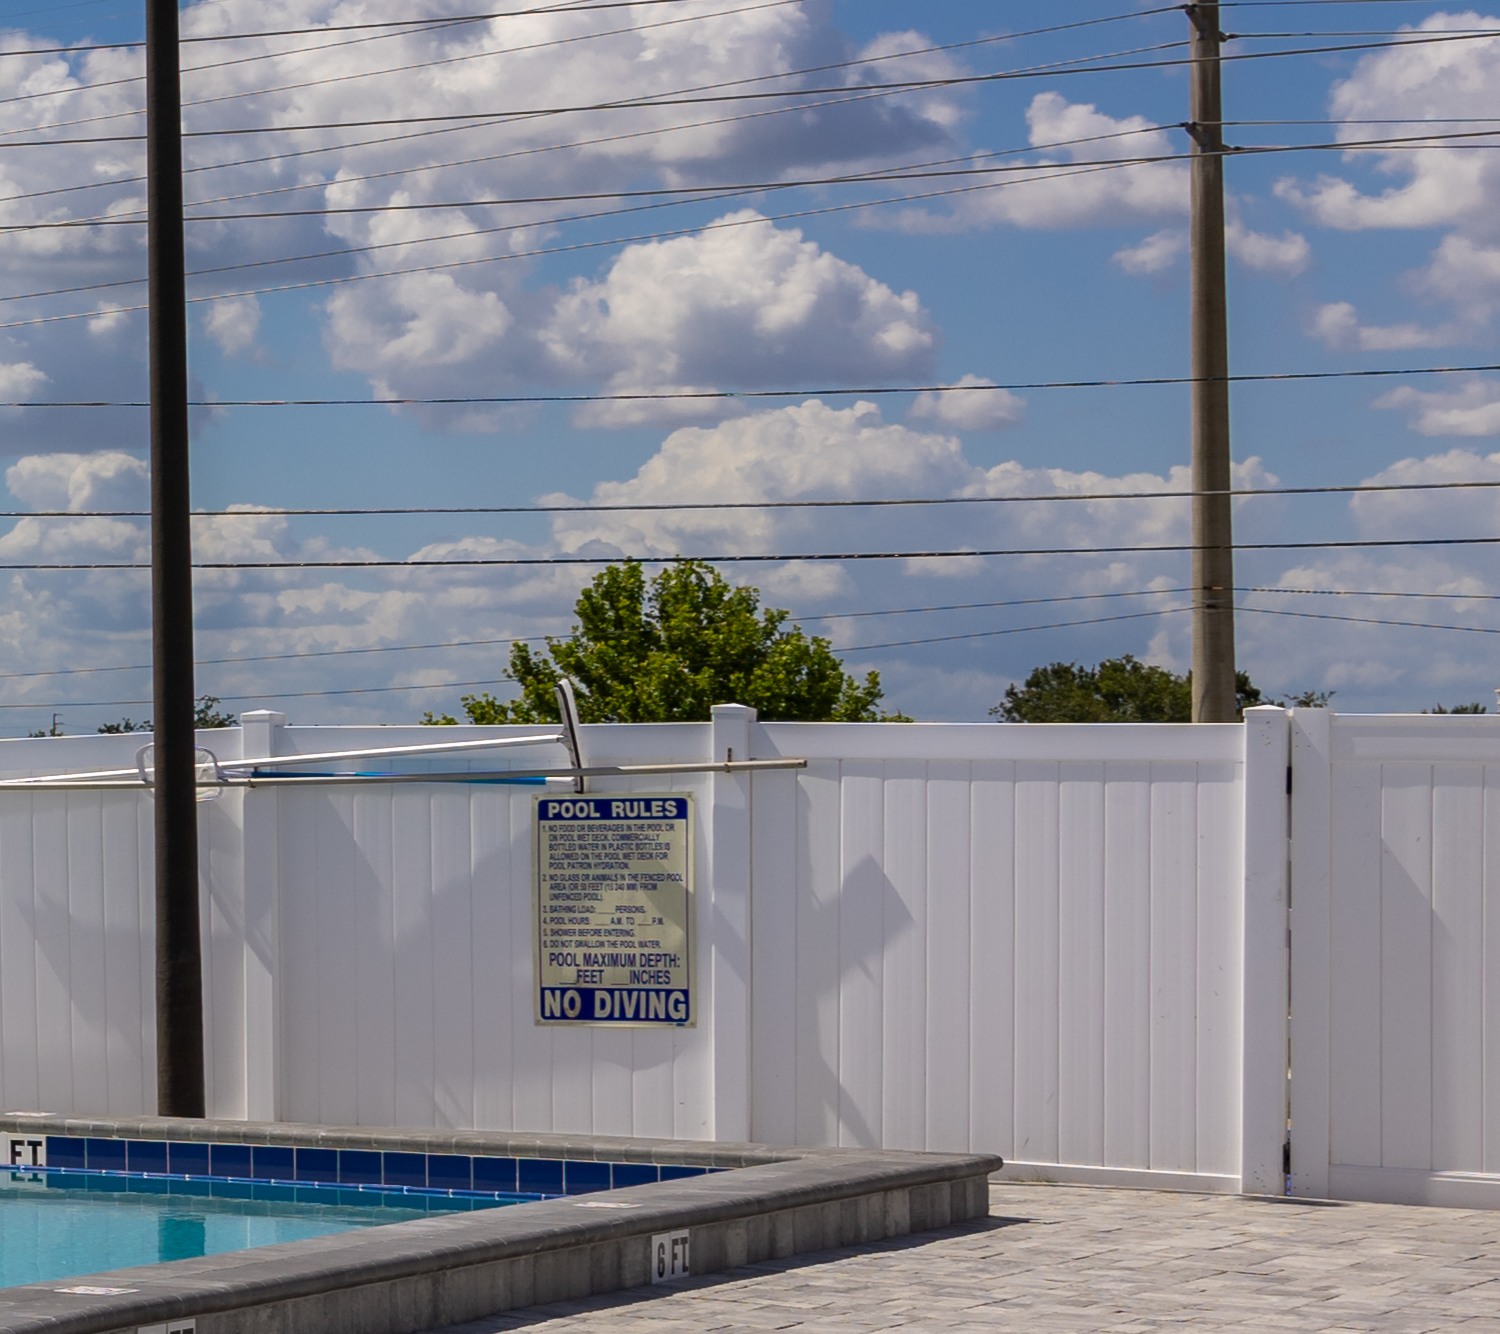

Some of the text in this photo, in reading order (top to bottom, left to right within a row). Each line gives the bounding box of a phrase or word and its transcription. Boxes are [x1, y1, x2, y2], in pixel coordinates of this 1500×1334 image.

[548, 800, 678, 818] POOL RULES
[549, 952, 680, 968] POOL MAXIMUM DEPTH:
[577, 969, 671, 984] FEET INCHES
[544, 989, 686, 1019] NO DIVING
[657, 1242, 665, 1278] 6
